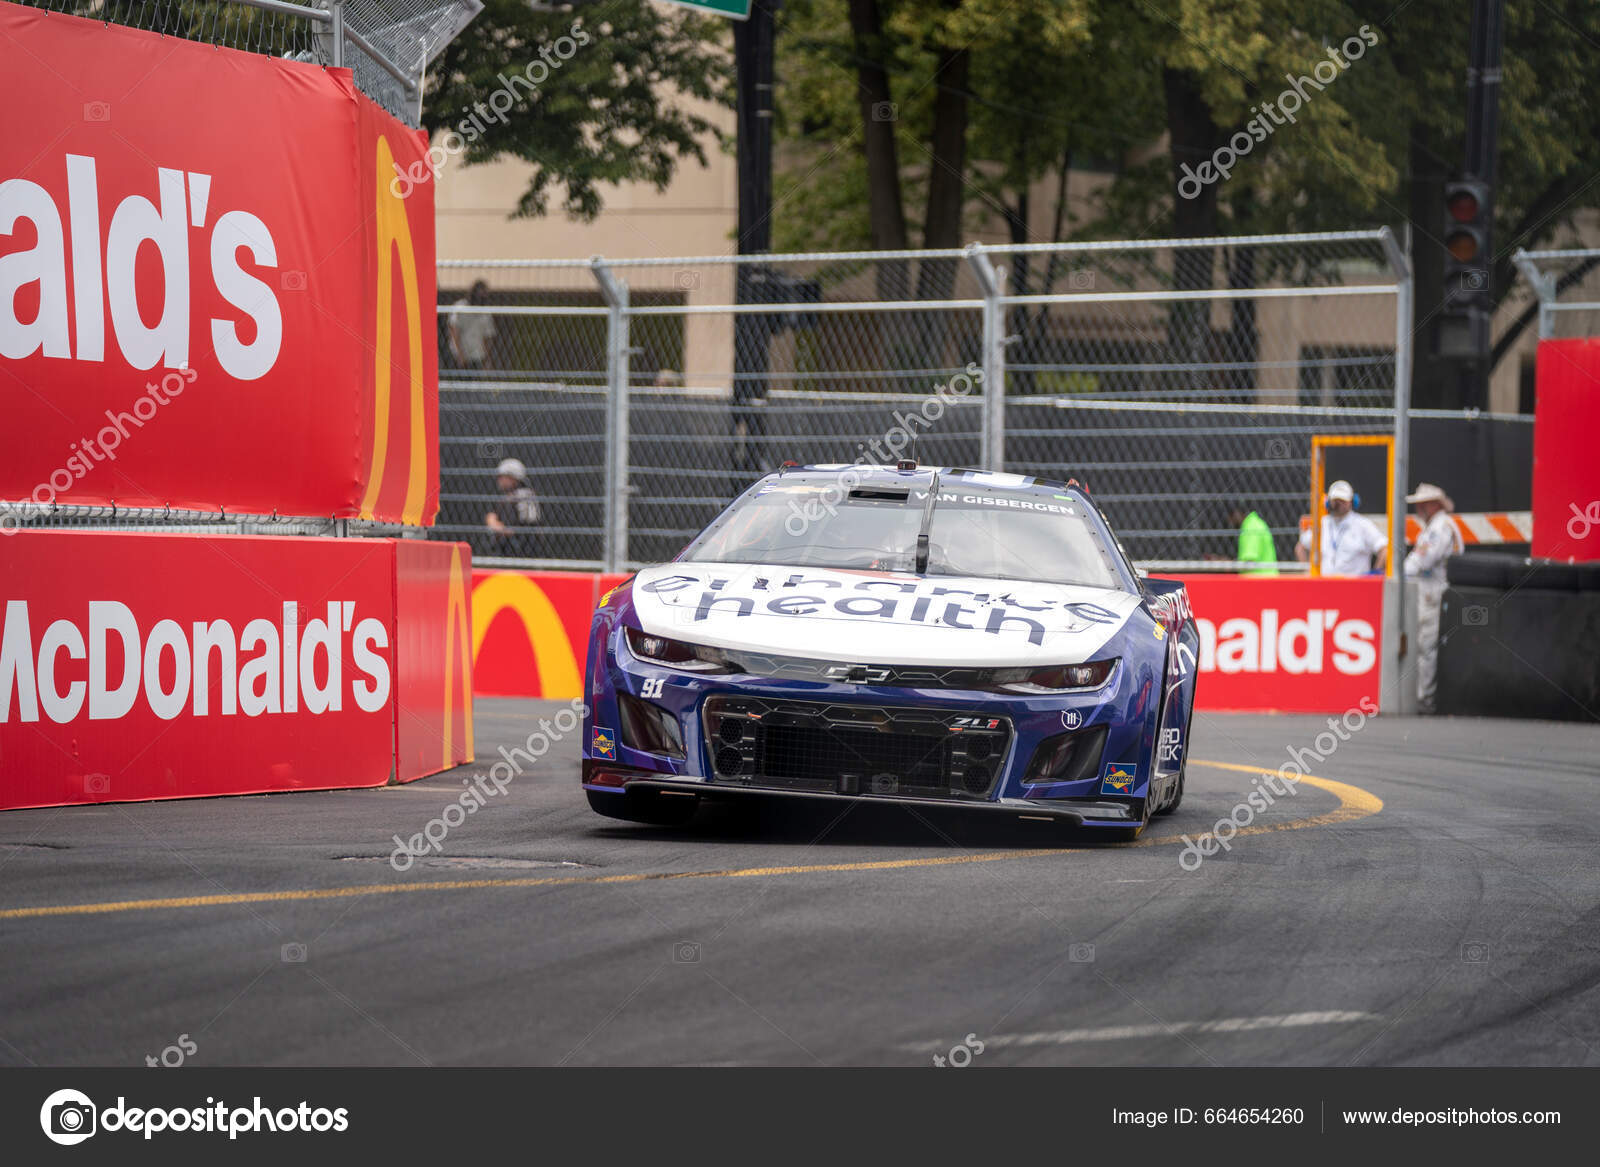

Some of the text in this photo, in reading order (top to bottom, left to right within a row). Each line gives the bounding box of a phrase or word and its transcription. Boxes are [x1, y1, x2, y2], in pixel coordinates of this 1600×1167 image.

[963, 495, 1075, 515] GISBERGEN
[694, 591, 1046, 647] health
[640, 678, 665, 698] 91
[950, 717, 1000, 729] ZL1
[1105, 774, 1134, 784] SUNOCO
